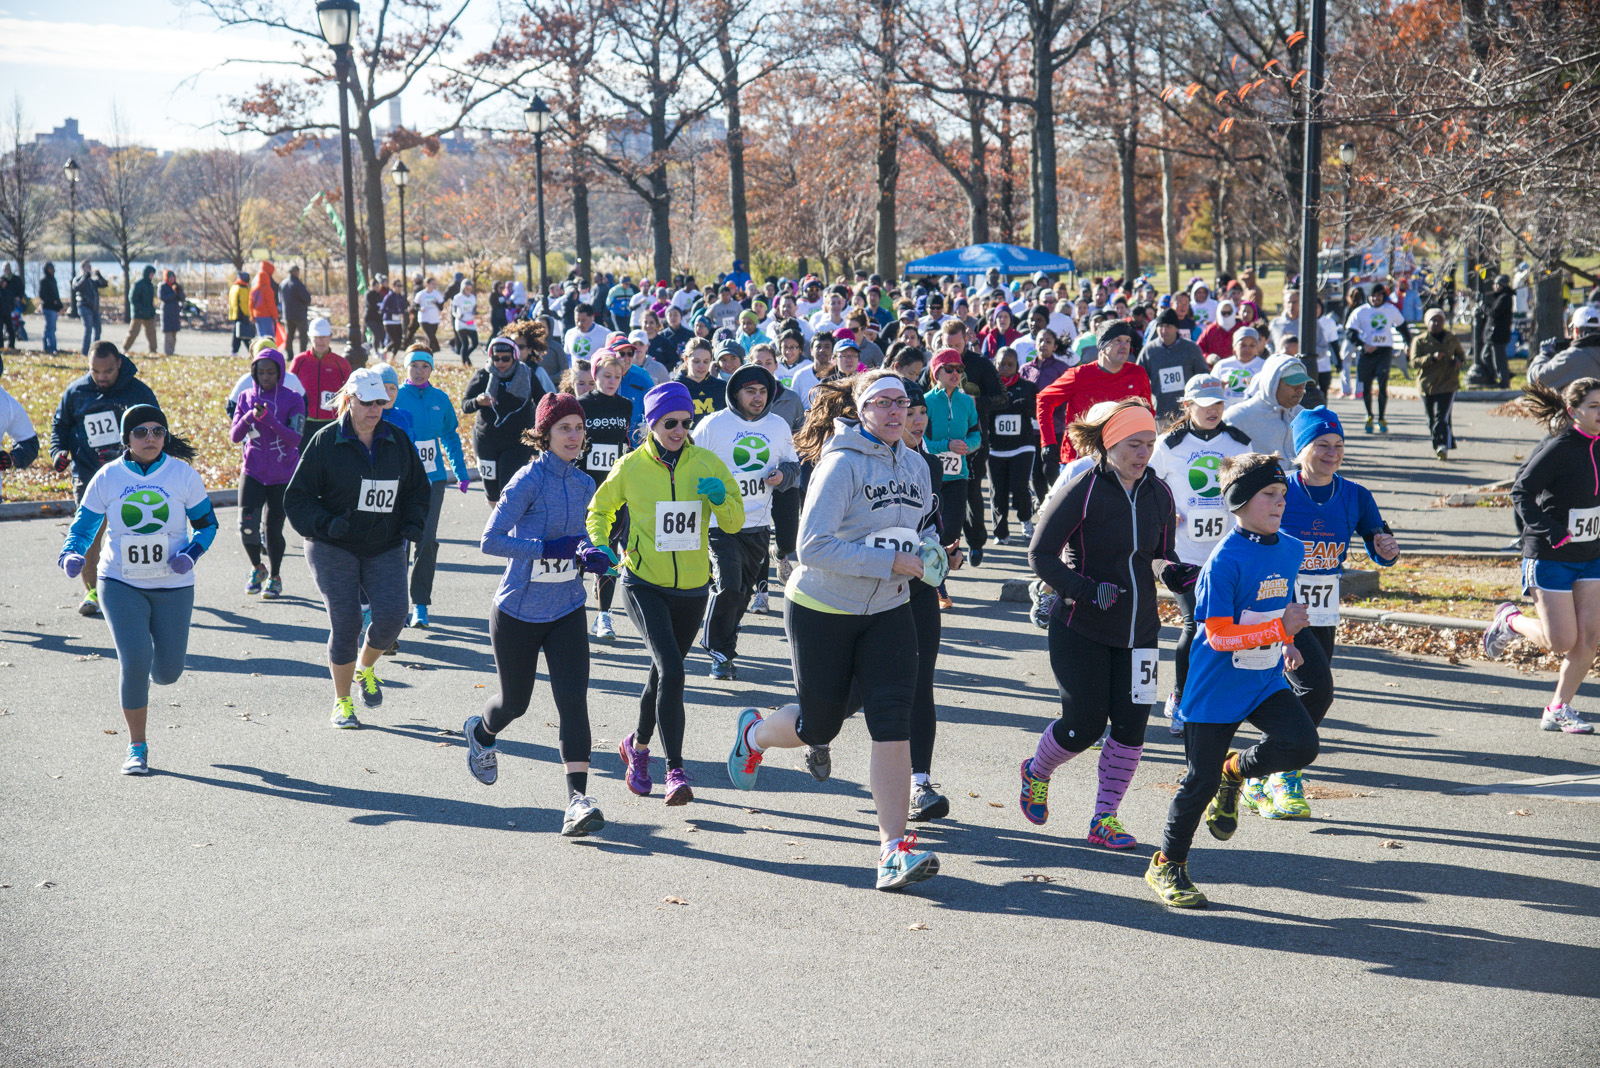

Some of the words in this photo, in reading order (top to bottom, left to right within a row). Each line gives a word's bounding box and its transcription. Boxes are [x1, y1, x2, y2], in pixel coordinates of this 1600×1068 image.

[1163, 371, 1181, 385] 280
[693, 397, 715, 415] M
[88, 418, 114, 436] 312
[998, 420, 1017, 432] 601
[592, 450, 616, 467] 616
[740, 477, 766, 497] 304
[864, 484, 888, 500] Cape
[364, 489, 394, 508] 602
[662, 511, 697, 534] 684
[1194, 517, 1223, 538] 545
[1574, 516, 1600, 537] 540
[127, 544, 163, 565] 618
[1303, 540, 1346, 559] EAM
[1255, 586, 1289, 601] MILERS
[1259, 578, 1289, 591] MIGHTY
[1300, 584, 1334, 608] 557
